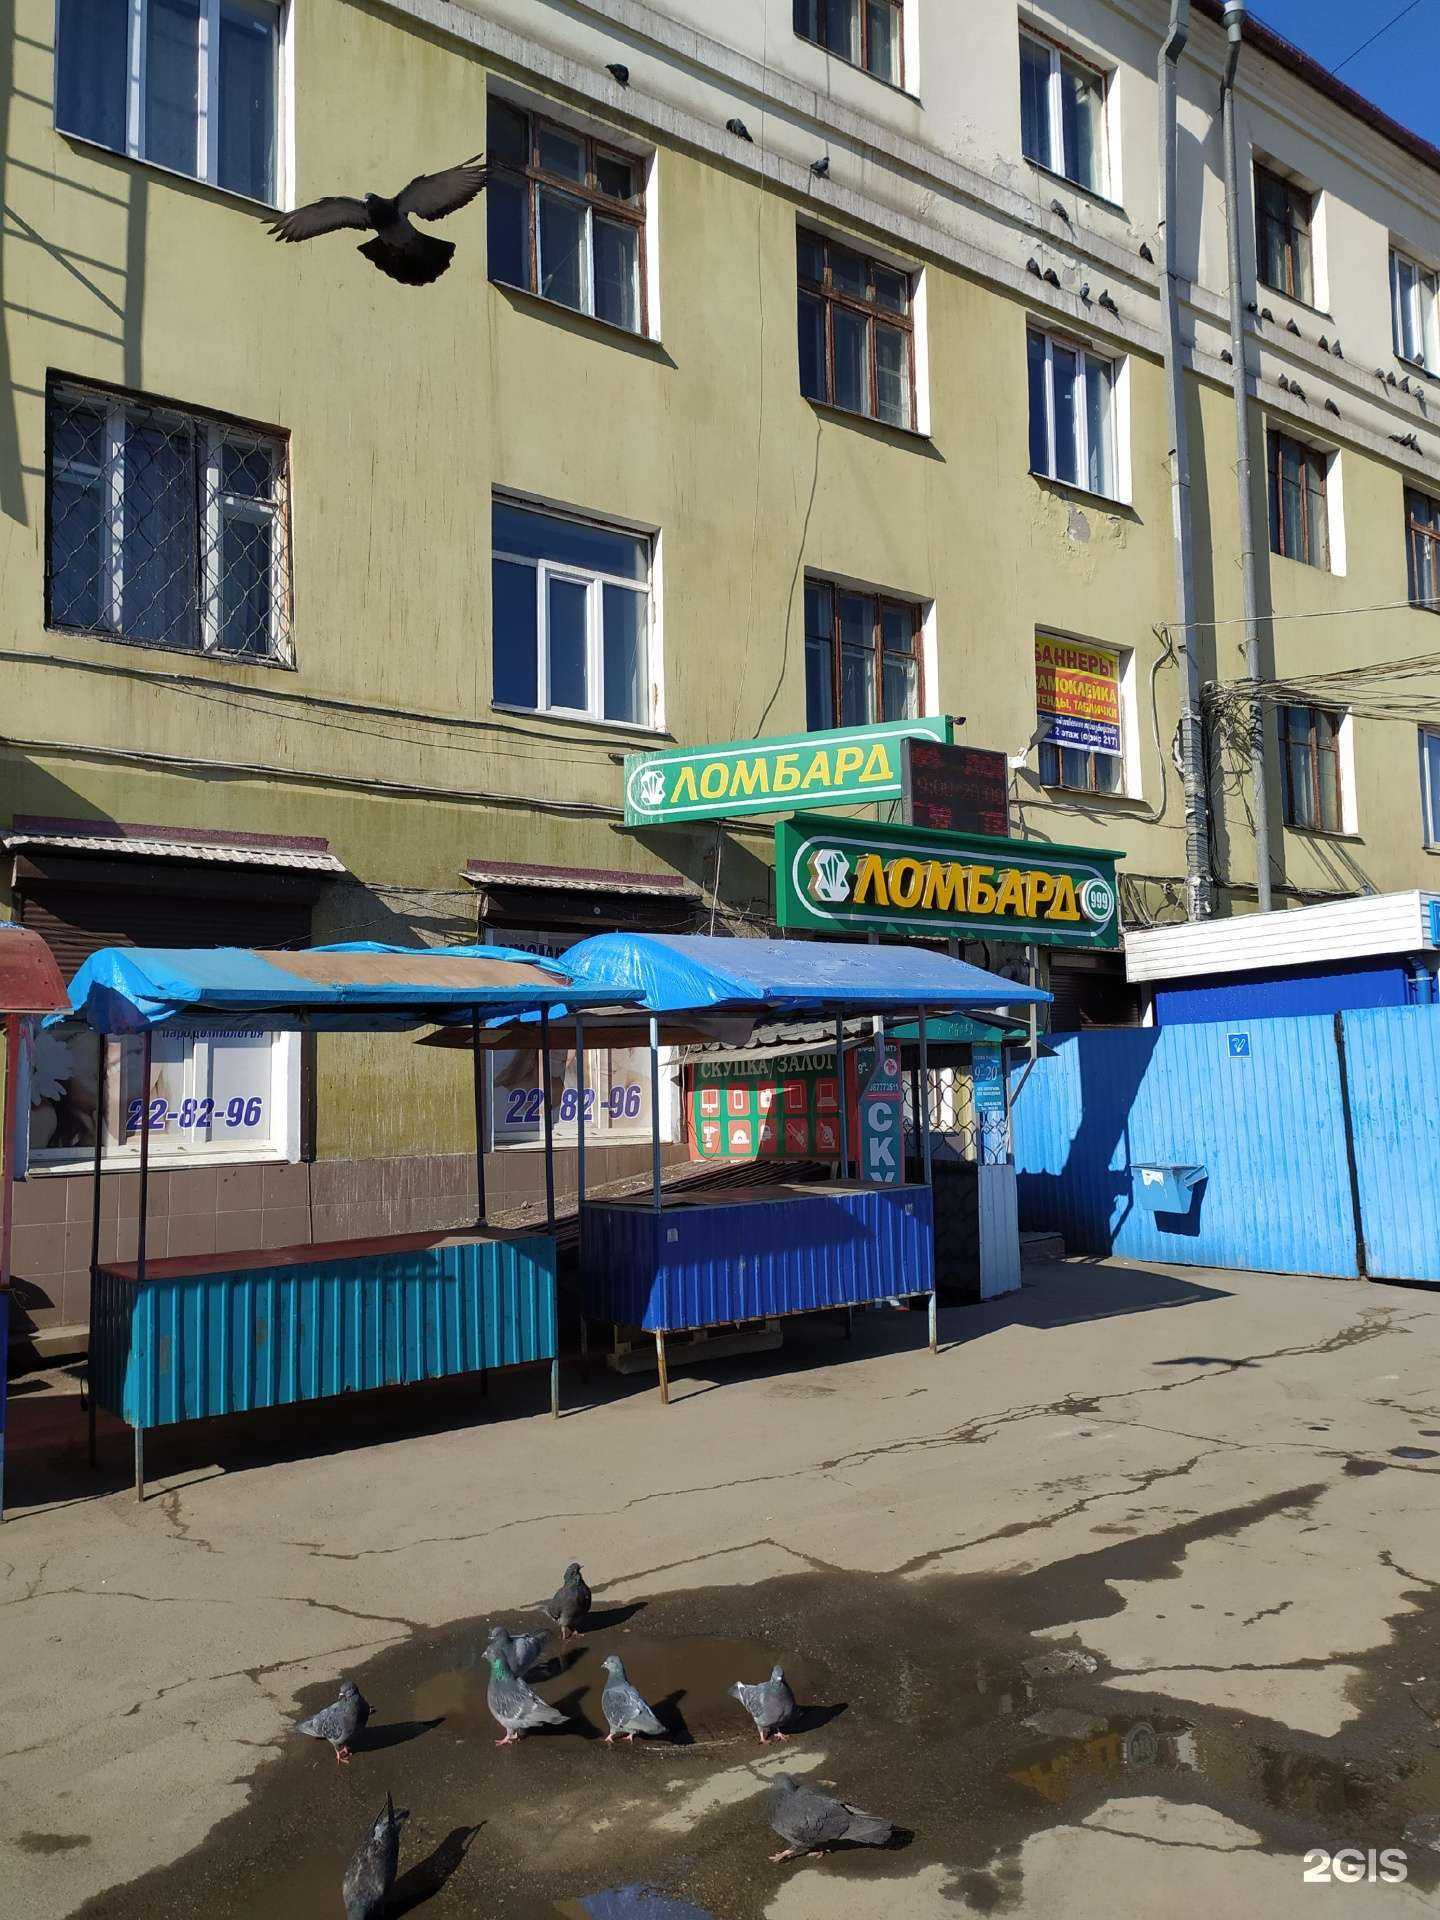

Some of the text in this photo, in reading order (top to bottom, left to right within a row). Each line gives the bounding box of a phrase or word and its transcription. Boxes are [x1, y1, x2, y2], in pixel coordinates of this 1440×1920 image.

[1036, 674, 1117, 704] АМОКЛЕЙКА
[1055, 726, 1060, 736] 2
[1061, 729, 1079, 740] этаж
[670, 743, 894, 803] ЛОМБАРД
[852, 852, 1081, 922] ЛОМБАРД
[1090, 889, 1109, 909] 999
[126, 1096, 263, 1130] 22-82-96
[504, 1084, 642, 1123] 2282-96
